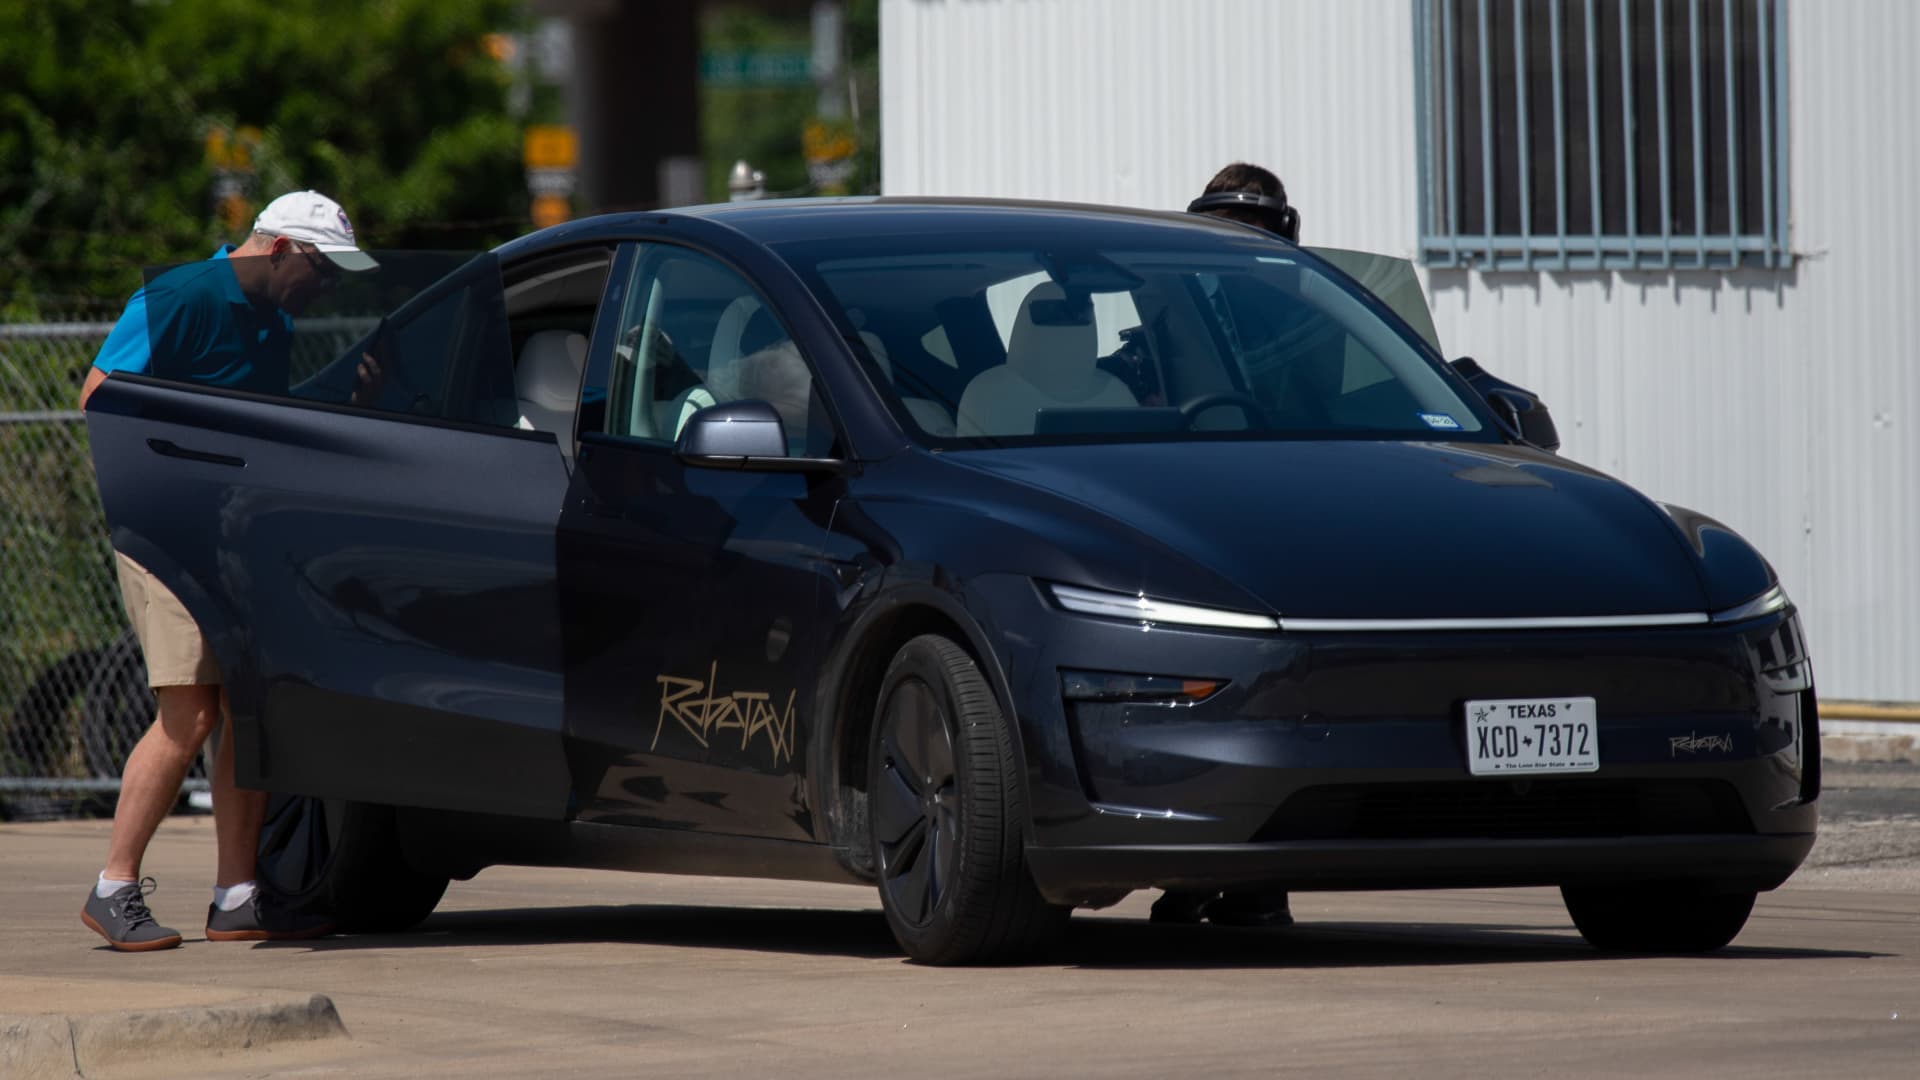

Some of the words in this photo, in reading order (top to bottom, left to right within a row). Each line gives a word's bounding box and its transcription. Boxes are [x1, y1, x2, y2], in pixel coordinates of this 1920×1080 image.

[1508, 704, 1556, 719] TEXAS
[1477, 725, 1518, 759] XCD
[1534, 723, 1590, 757] 7372
